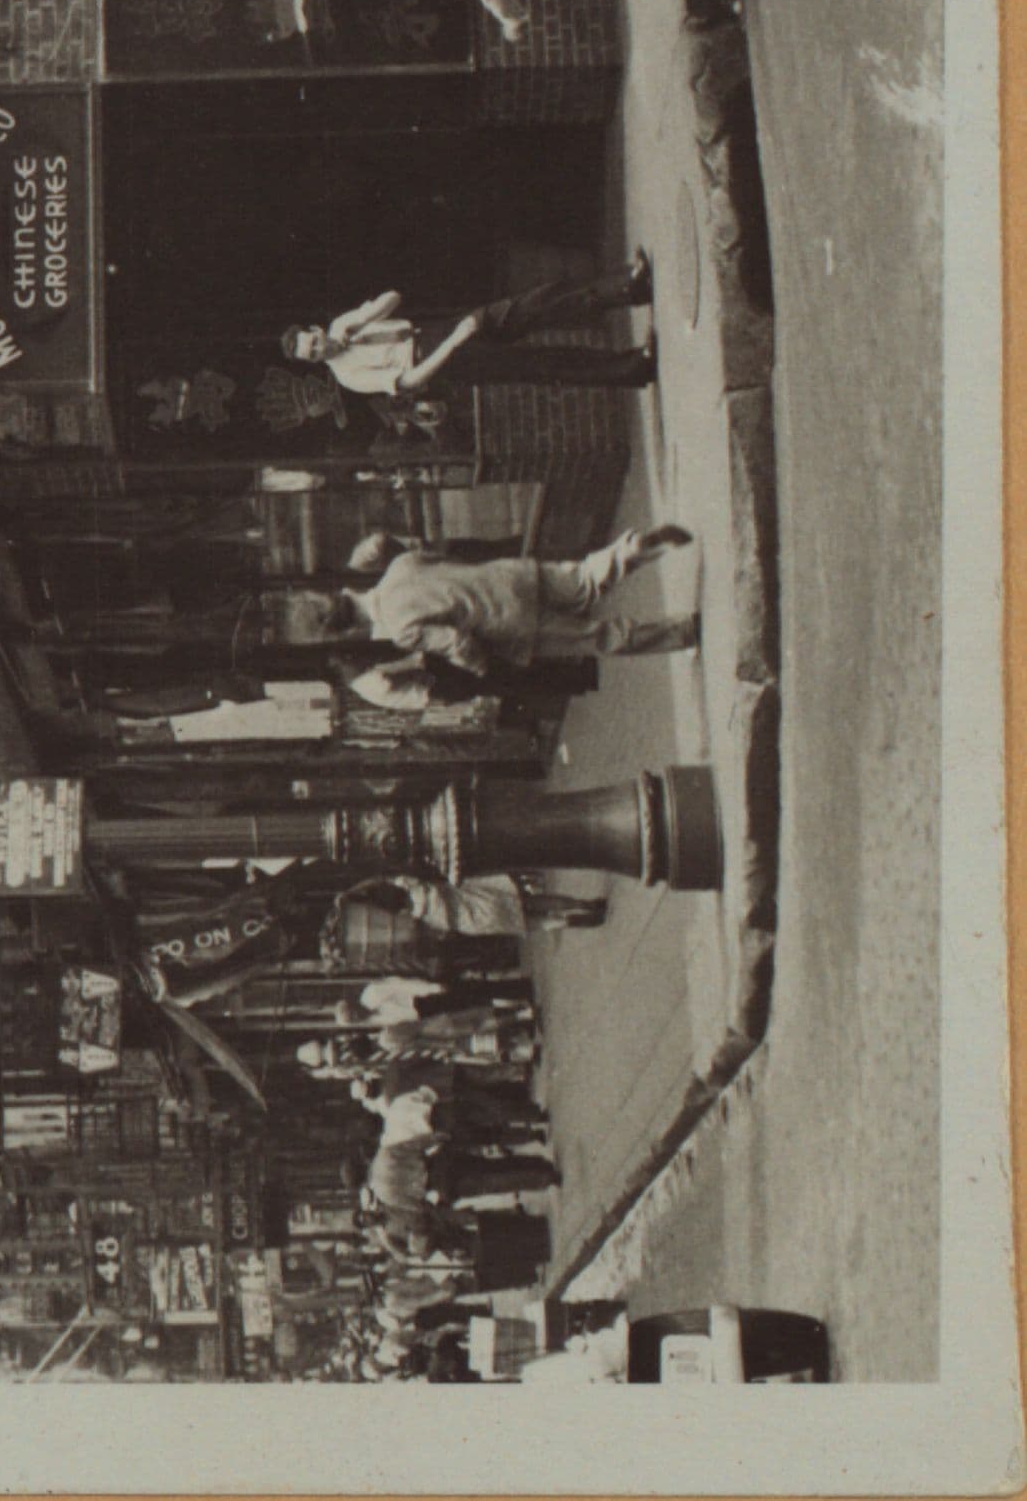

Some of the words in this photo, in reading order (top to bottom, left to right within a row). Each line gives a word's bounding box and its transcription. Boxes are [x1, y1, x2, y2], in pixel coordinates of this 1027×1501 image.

[12, 153, 39, 310] CHINESE
[43, 153, 69, 310] GROCERIES
[94, 1236, 121, 1284] 48
